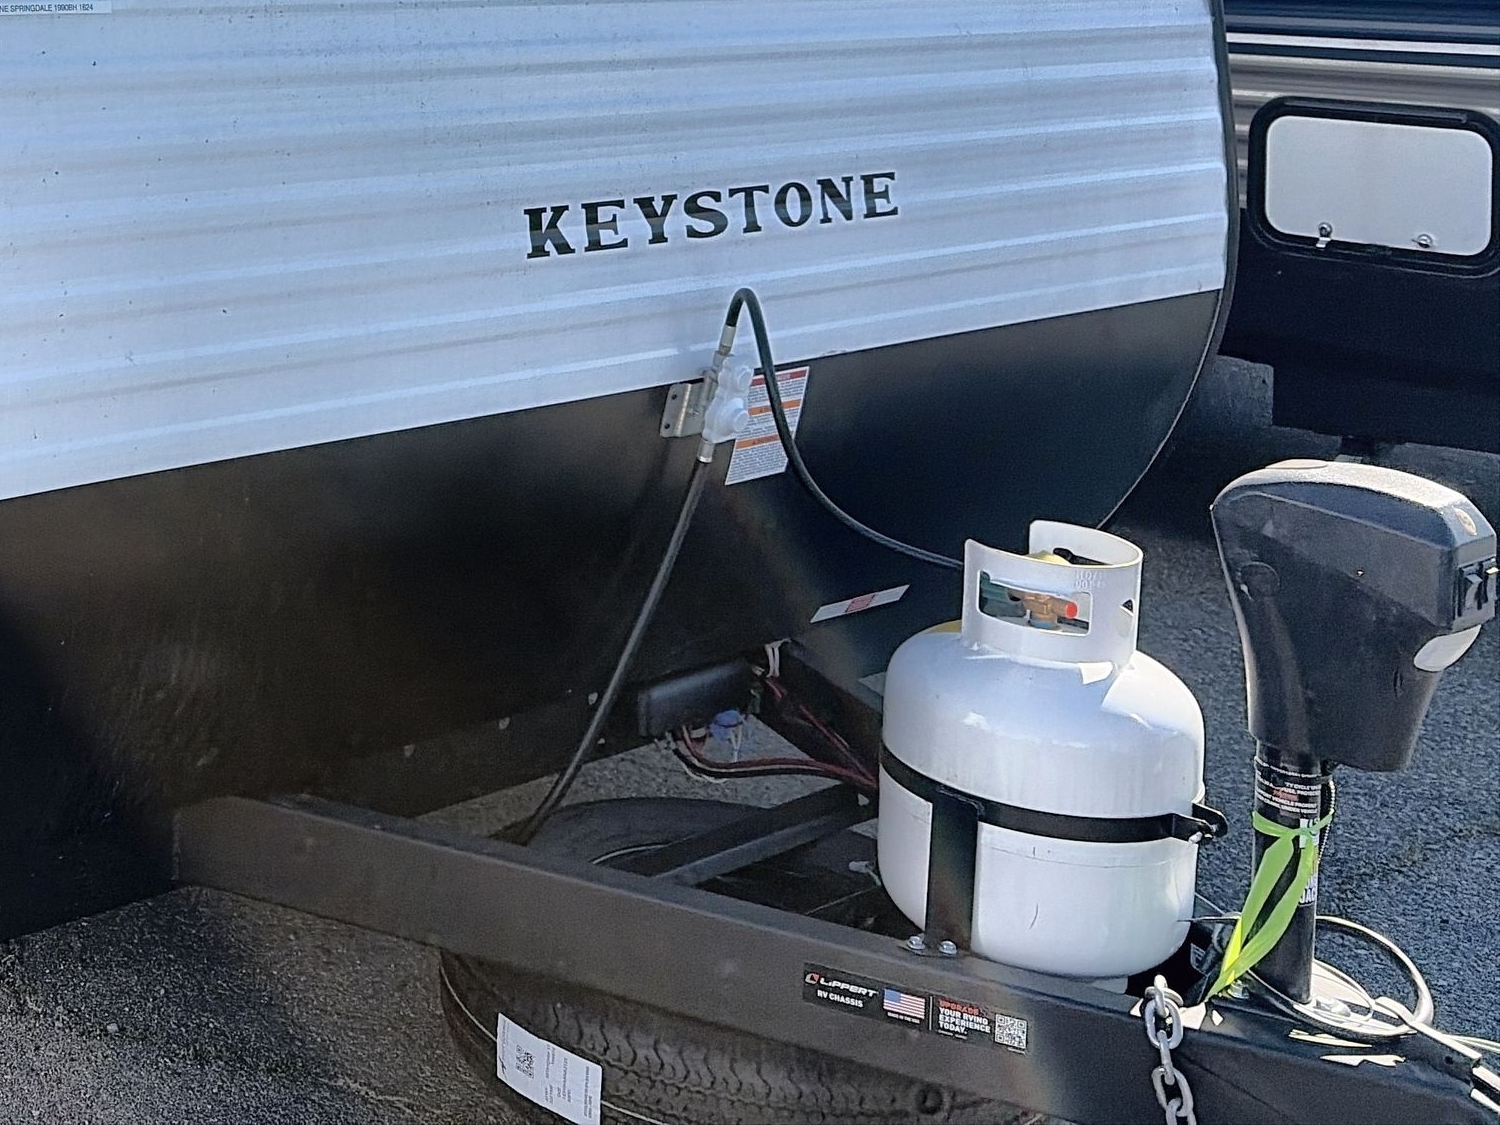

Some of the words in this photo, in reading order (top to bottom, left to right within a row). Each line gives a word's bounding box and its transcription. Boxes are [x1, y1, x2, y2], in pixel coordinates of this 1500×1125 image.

[10, 3, 53, 13] SPRINGDALE
[523, 171, 899, 259] KEYSTONE
[819, 977, 877, 997] LIPPERT
[817, 989, 828, 999] RV
[829, 993, 863, 1008] CHASSIS
[939, 1007, 962, 1019] YOUR
[963, 1012, 989, 1025] RVING
[939, 1014, 991, 1033] EXPERIENCE
[939, 1021, 968, 1035] TODAY.
